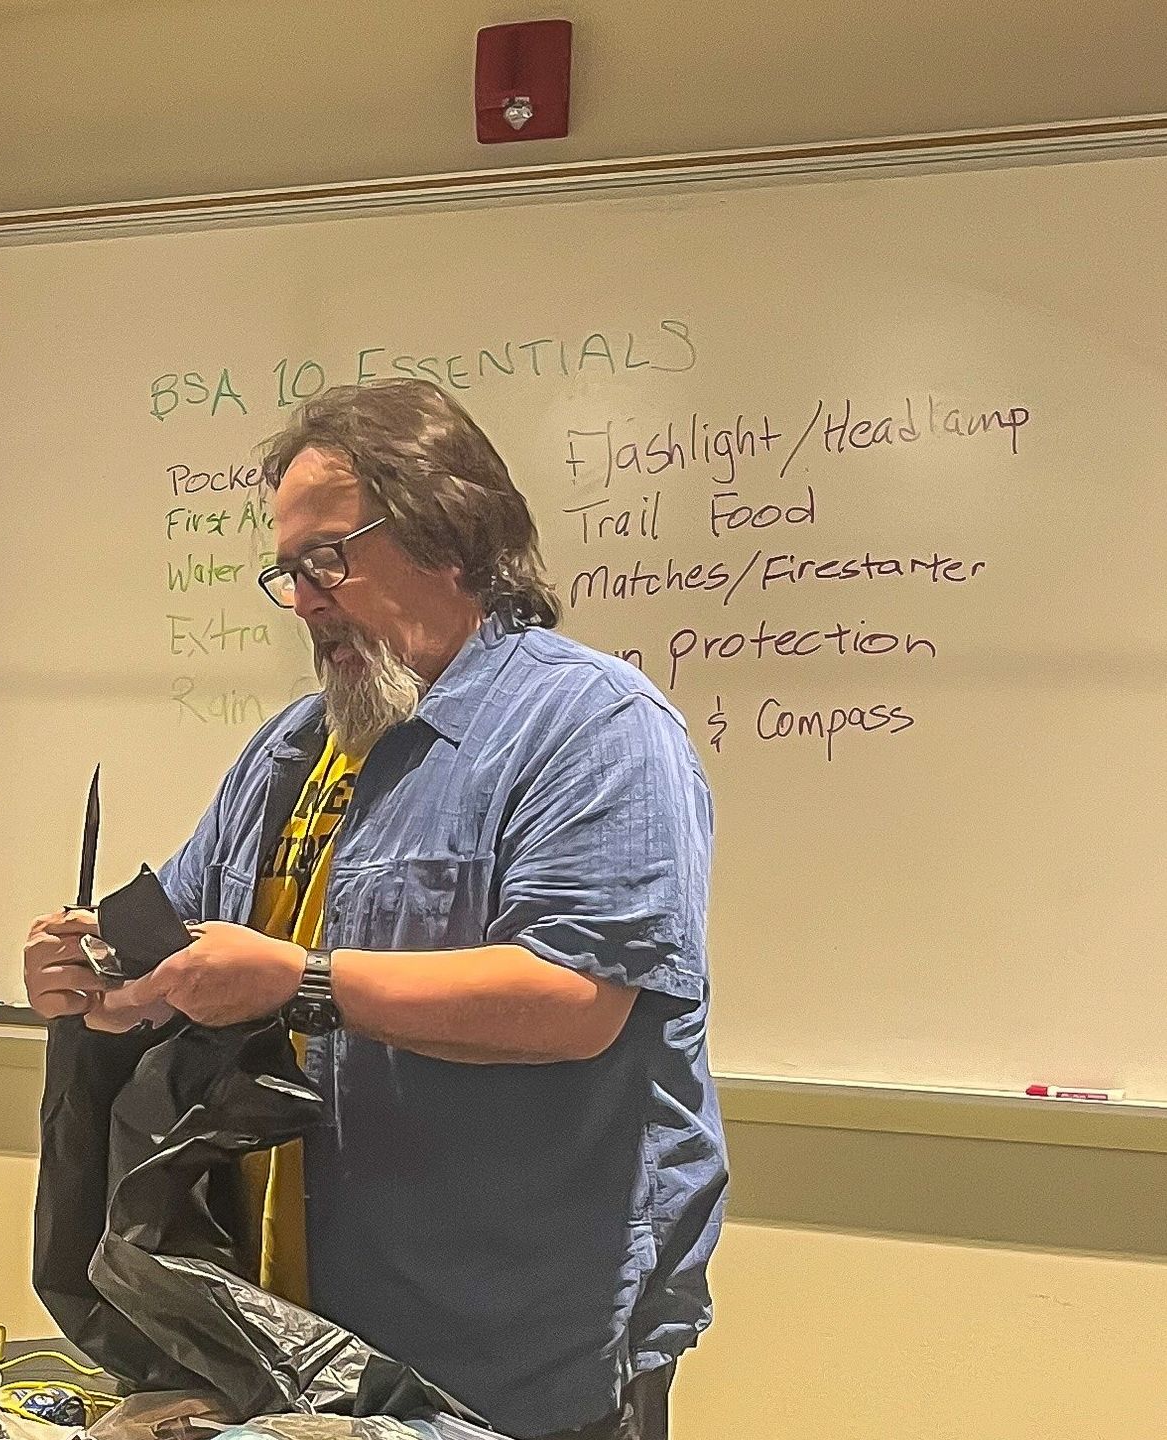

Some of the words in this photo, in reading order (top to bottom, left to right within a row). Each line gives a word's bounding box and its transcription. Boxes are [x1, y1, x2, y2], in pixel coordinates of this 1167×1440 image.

[150, 368, 247, 421] BSA
[273, 358, 326, 407] 10
[357, 320, 696, 389] ESSENTIALS
[167, 464, 265, 497] Pocke
[165, 506, 232, 540] First
[562, 491, 660, 544] Trail
[710, 486, 816, 538] Food
[167, 553, 244, 592] Water
[166, 608, 271, 657] Extra
[169, 676, 265, 725] Rain
[756, 698, 915, 761] Compass
